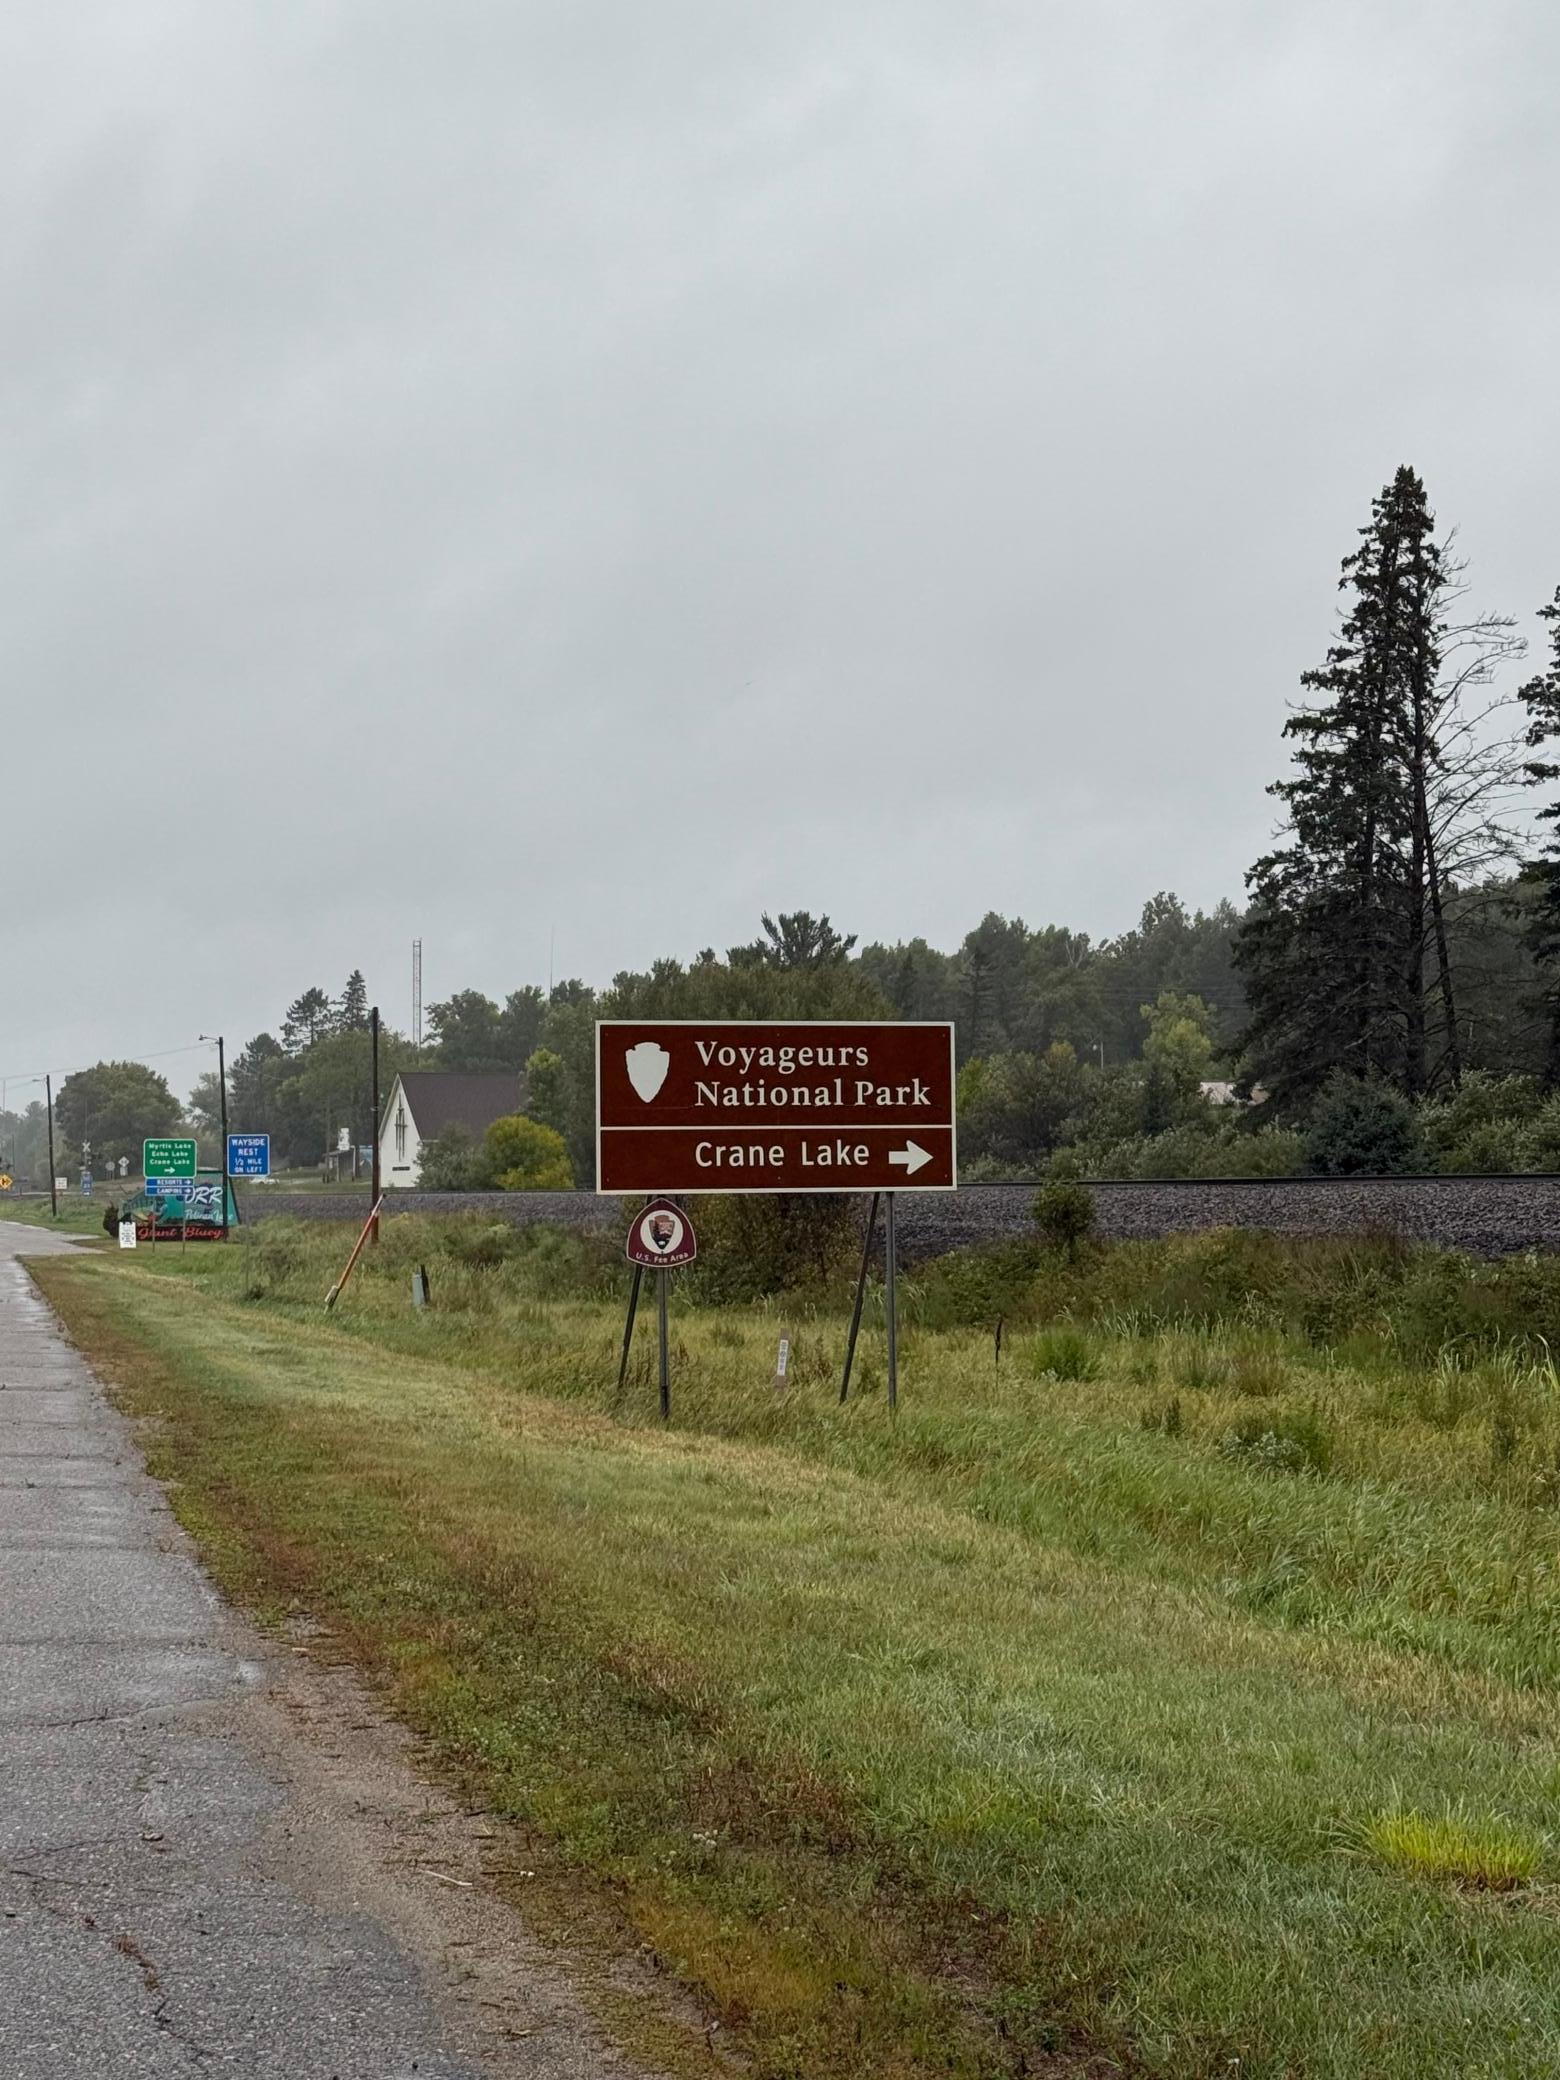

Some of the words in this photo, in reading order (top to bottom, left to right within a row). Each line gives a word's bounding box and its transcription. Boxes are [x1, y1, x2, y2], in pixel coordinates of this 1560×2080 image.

[694, 1040, 869, 1074] Voyageurs
[694, 1078, 844, 1107] National
[854, 1078, 932, 1106] Park
[231, 1138, 265, 1146] WAYSIDE
[238, 1148, 258, 1156] REST
[695, 1141, 785, 1168] Crane
[801, 1139, 870, 1166] Lake
[654, 1256, 668, 1264] Fee
[671, 1252, 688, 1262] Area
